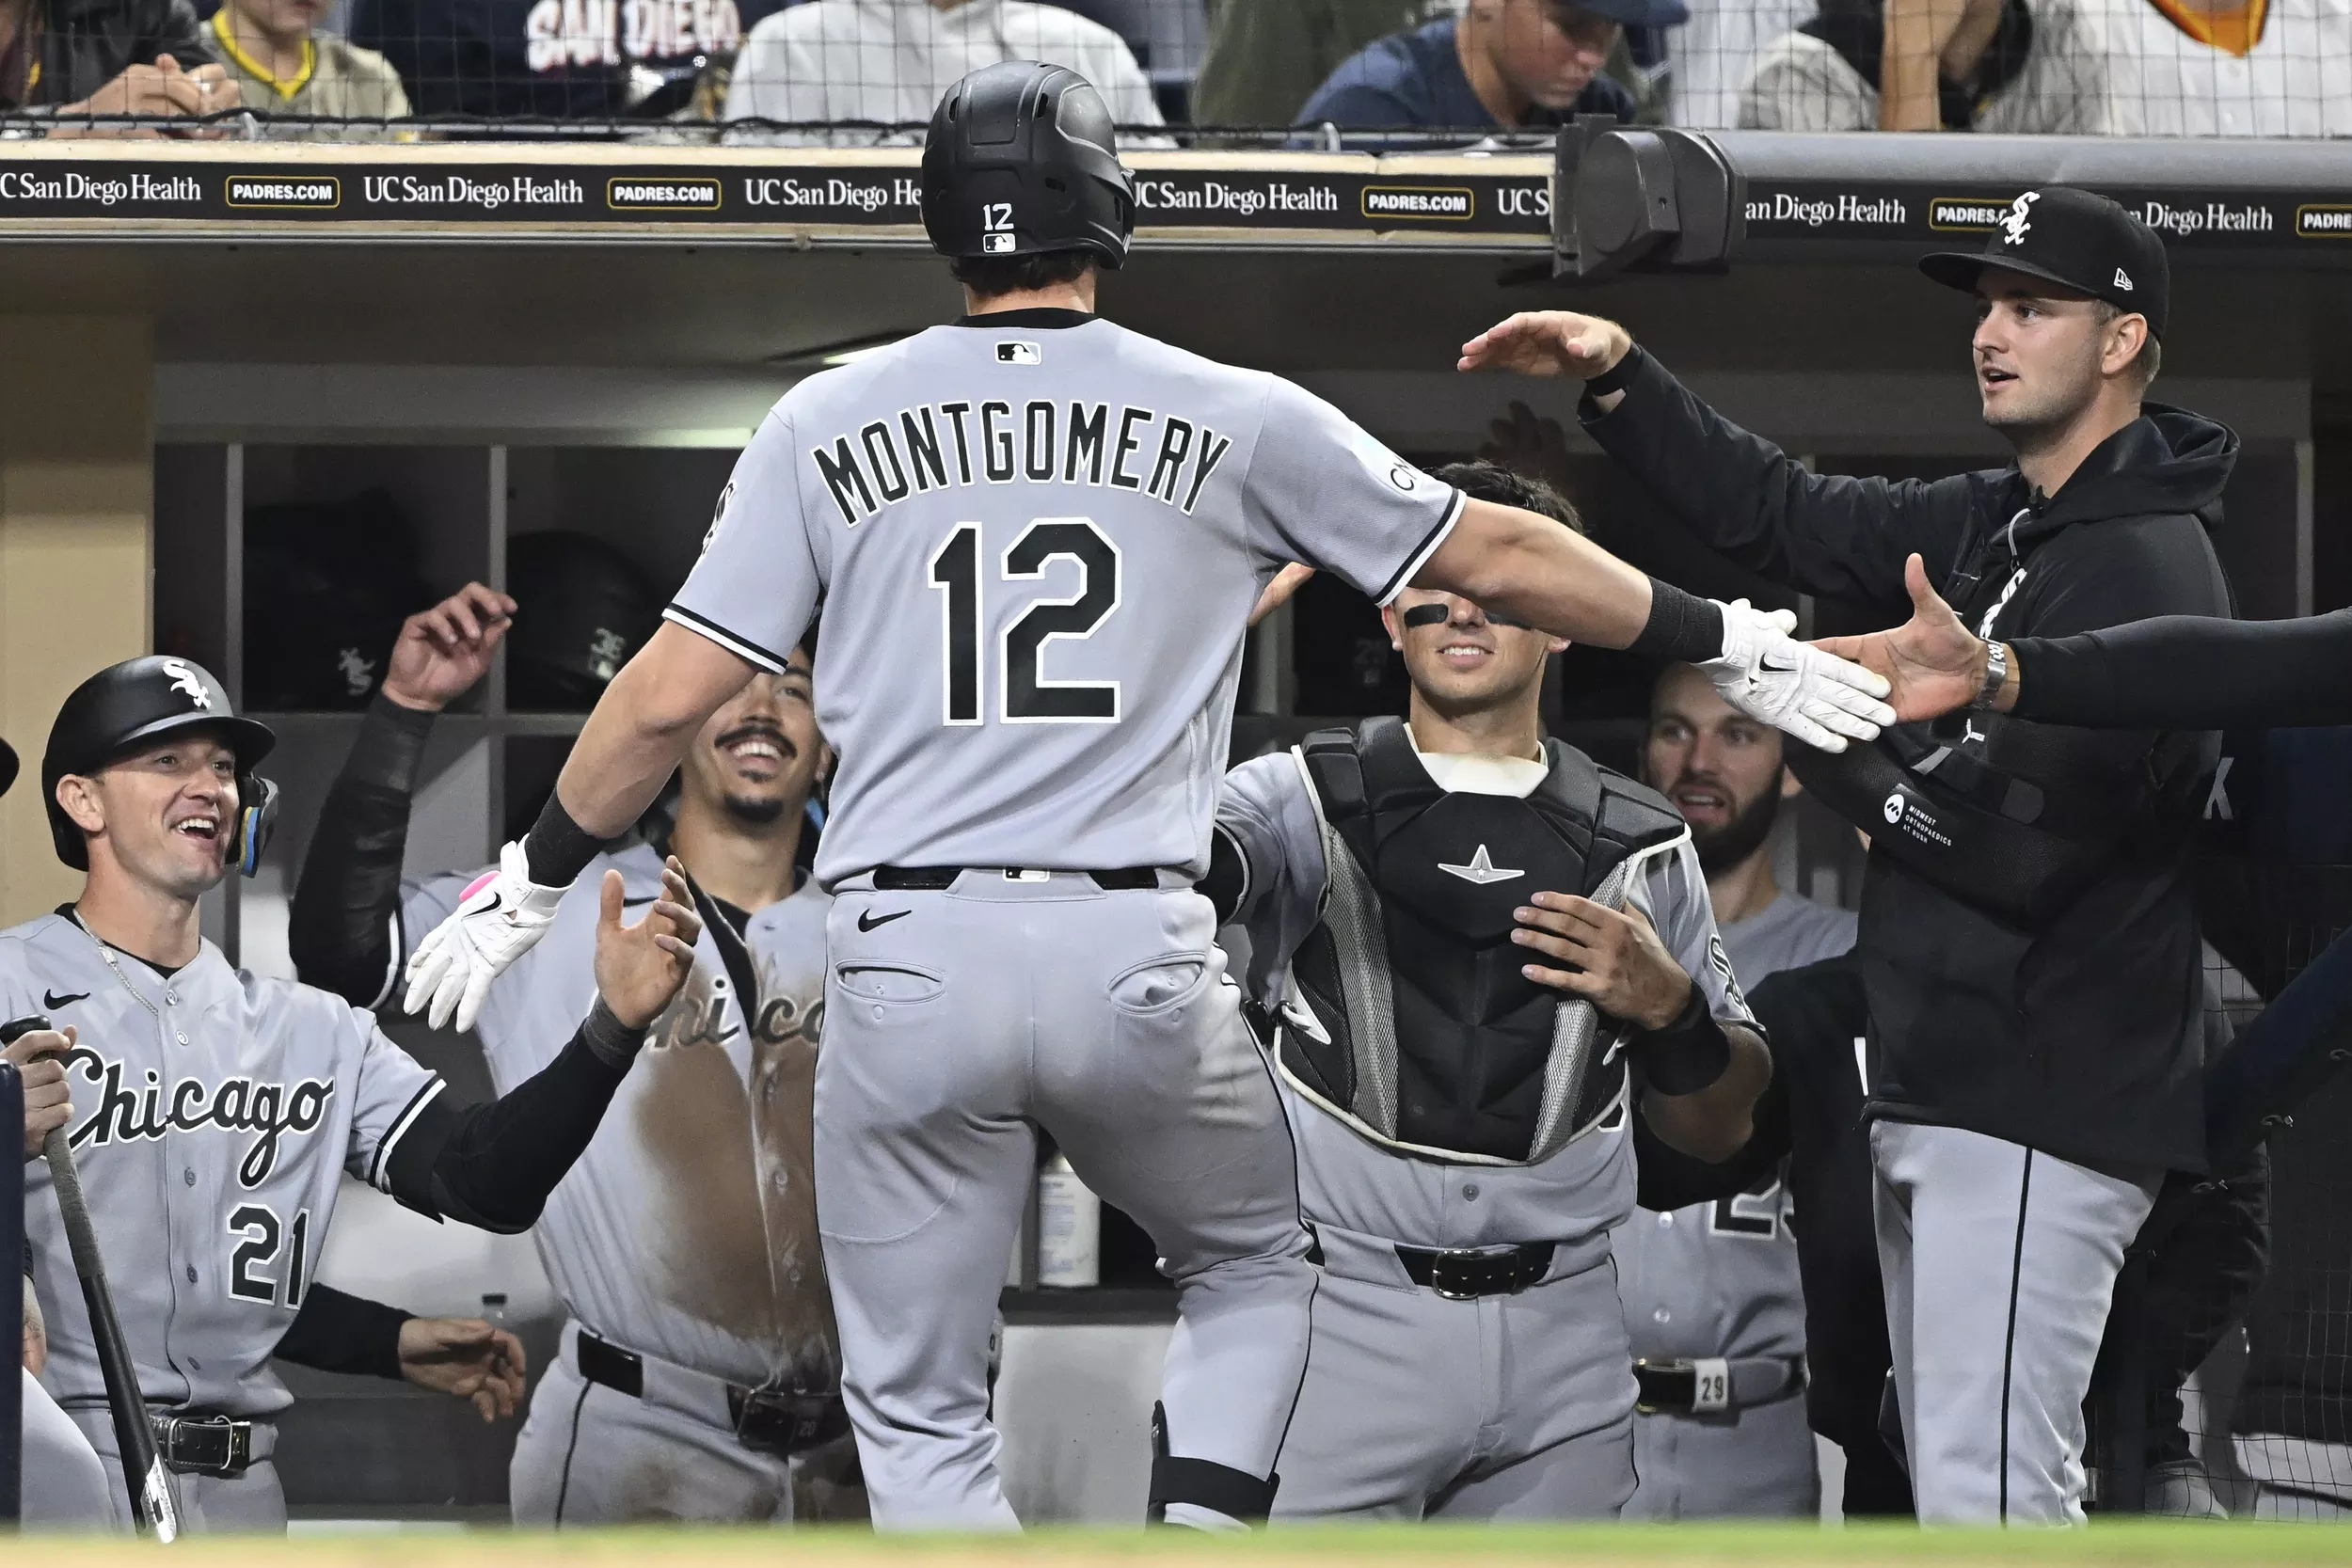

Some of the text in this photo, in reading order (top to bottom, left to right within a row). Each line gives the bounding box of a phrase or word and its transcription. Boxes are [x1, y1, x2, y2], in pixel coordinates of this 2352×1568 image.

[0, 172, 202, 205] C San Diego Health
[232, 183, 333, 200] PADRES.COM
[364, 176, 583, 208] UC San Diego Health
[614, 185, 715, 202] PADRES.COM
[745, 179, 781, 206] UC
[783, 179, 824, 206] San
[828, 180, 888, 212] Diego
[1160, 182, 1201, 209] San
[1205, 182, 1265, 214] Diego
[1268, 183, 1338, 211] Health
[1368, 194, 1467, 212] PADRES.COM
[1498, 189, 1534, 215] UC
[983, 202, 1015, 231] 12
[1745, 194, 1906, 227] an Diego Health
[2146, 201, 2274, 235] Diego Health
[2304, 213, 2352, 230] PADRE
[810, 399, 1233, 528] MONTGOMERY
[928, 516, 1121, 727] 12
[1905, 815, 1951, 846] ORTHOPAEDICS
[1908, 805, 1936, 825] MIDWEST
[60, 1044, 335, 1191] Chicago
[226, 1202, 310, 1309] 21
[1701, 1375, 1724, 1402] 29
